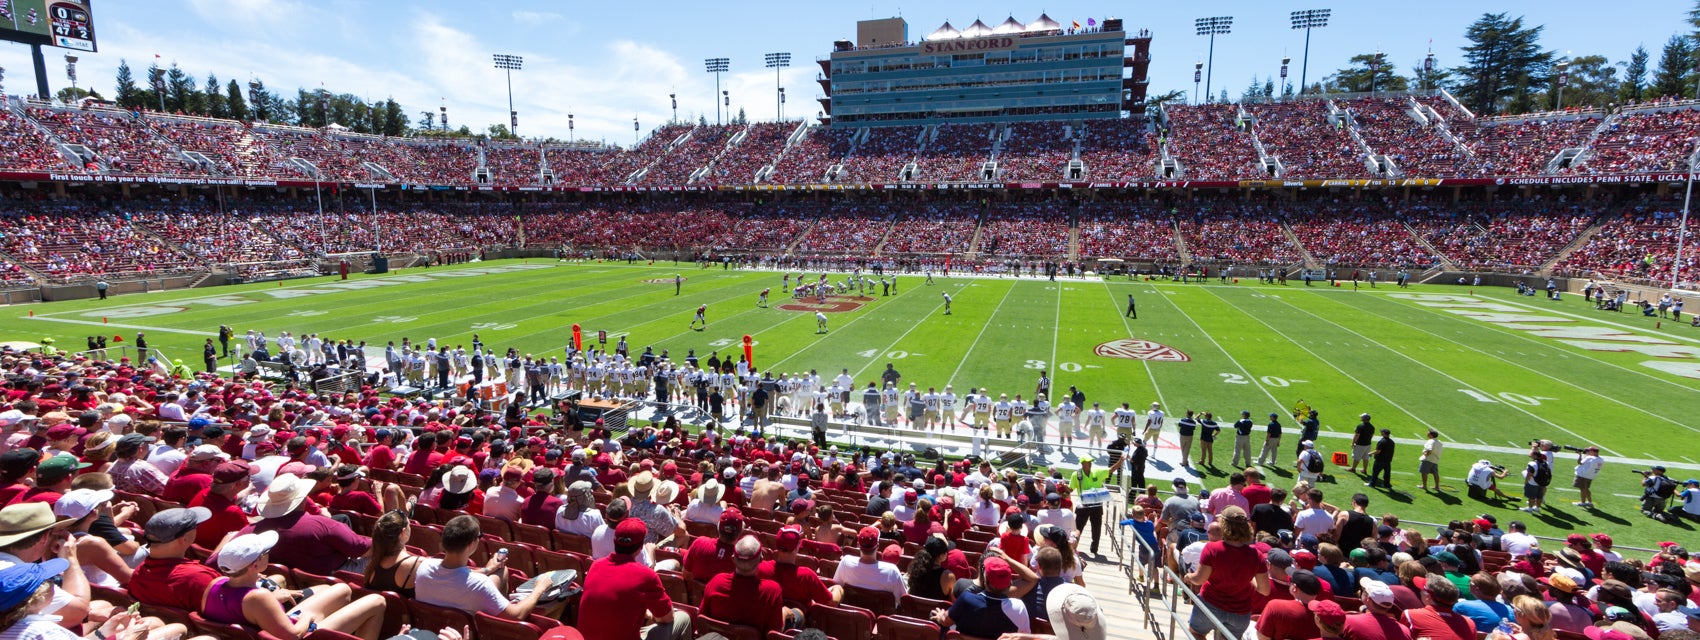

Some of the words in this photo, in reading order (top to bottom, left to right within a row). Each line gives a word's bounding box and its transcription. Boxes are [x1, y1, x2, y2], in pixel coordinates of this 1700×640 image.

[57, 7, 68, 19] 0
[56, 27, 70, 36] 47
[80, 31, 88, 39] 2
[924, 37, 1013, 53] STANFORD
[857, 348, 908, 360] 40
[1023, 359, 1082, 372] 30
[1218, 372, 1290, 388] 20
[1456, 389, 1541, 406] 10
[1014, 406, 1023, 415] 20
[1093, 415, 1102, 424] 47
[1120, 415, 1130, 424] 78
[1335, 454, 1348, 465] 20
